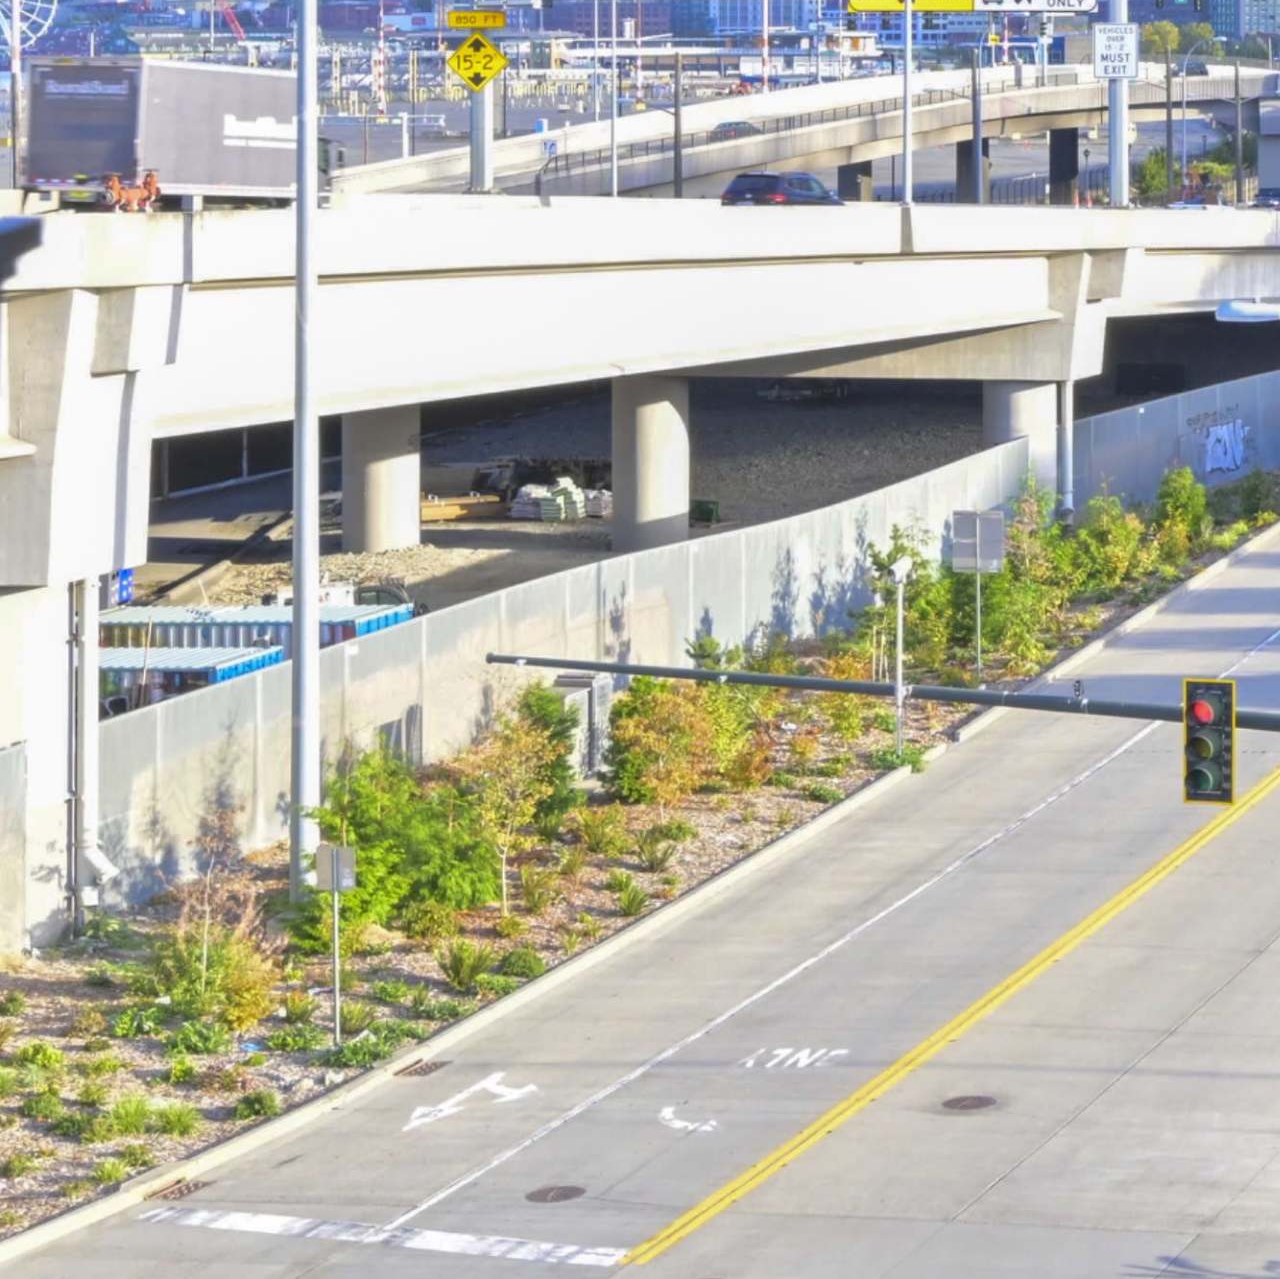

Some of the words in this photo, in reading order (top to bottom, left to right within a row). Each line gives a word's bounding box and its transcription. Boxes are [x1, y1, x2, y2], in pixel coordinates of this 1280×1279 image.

[484, 15, 497, 24] FT
[456, 54, 493, 70] 15-2
[1100, 53, 1130, 62] MUST
[1104, 65, 1127, 75] EXIT
